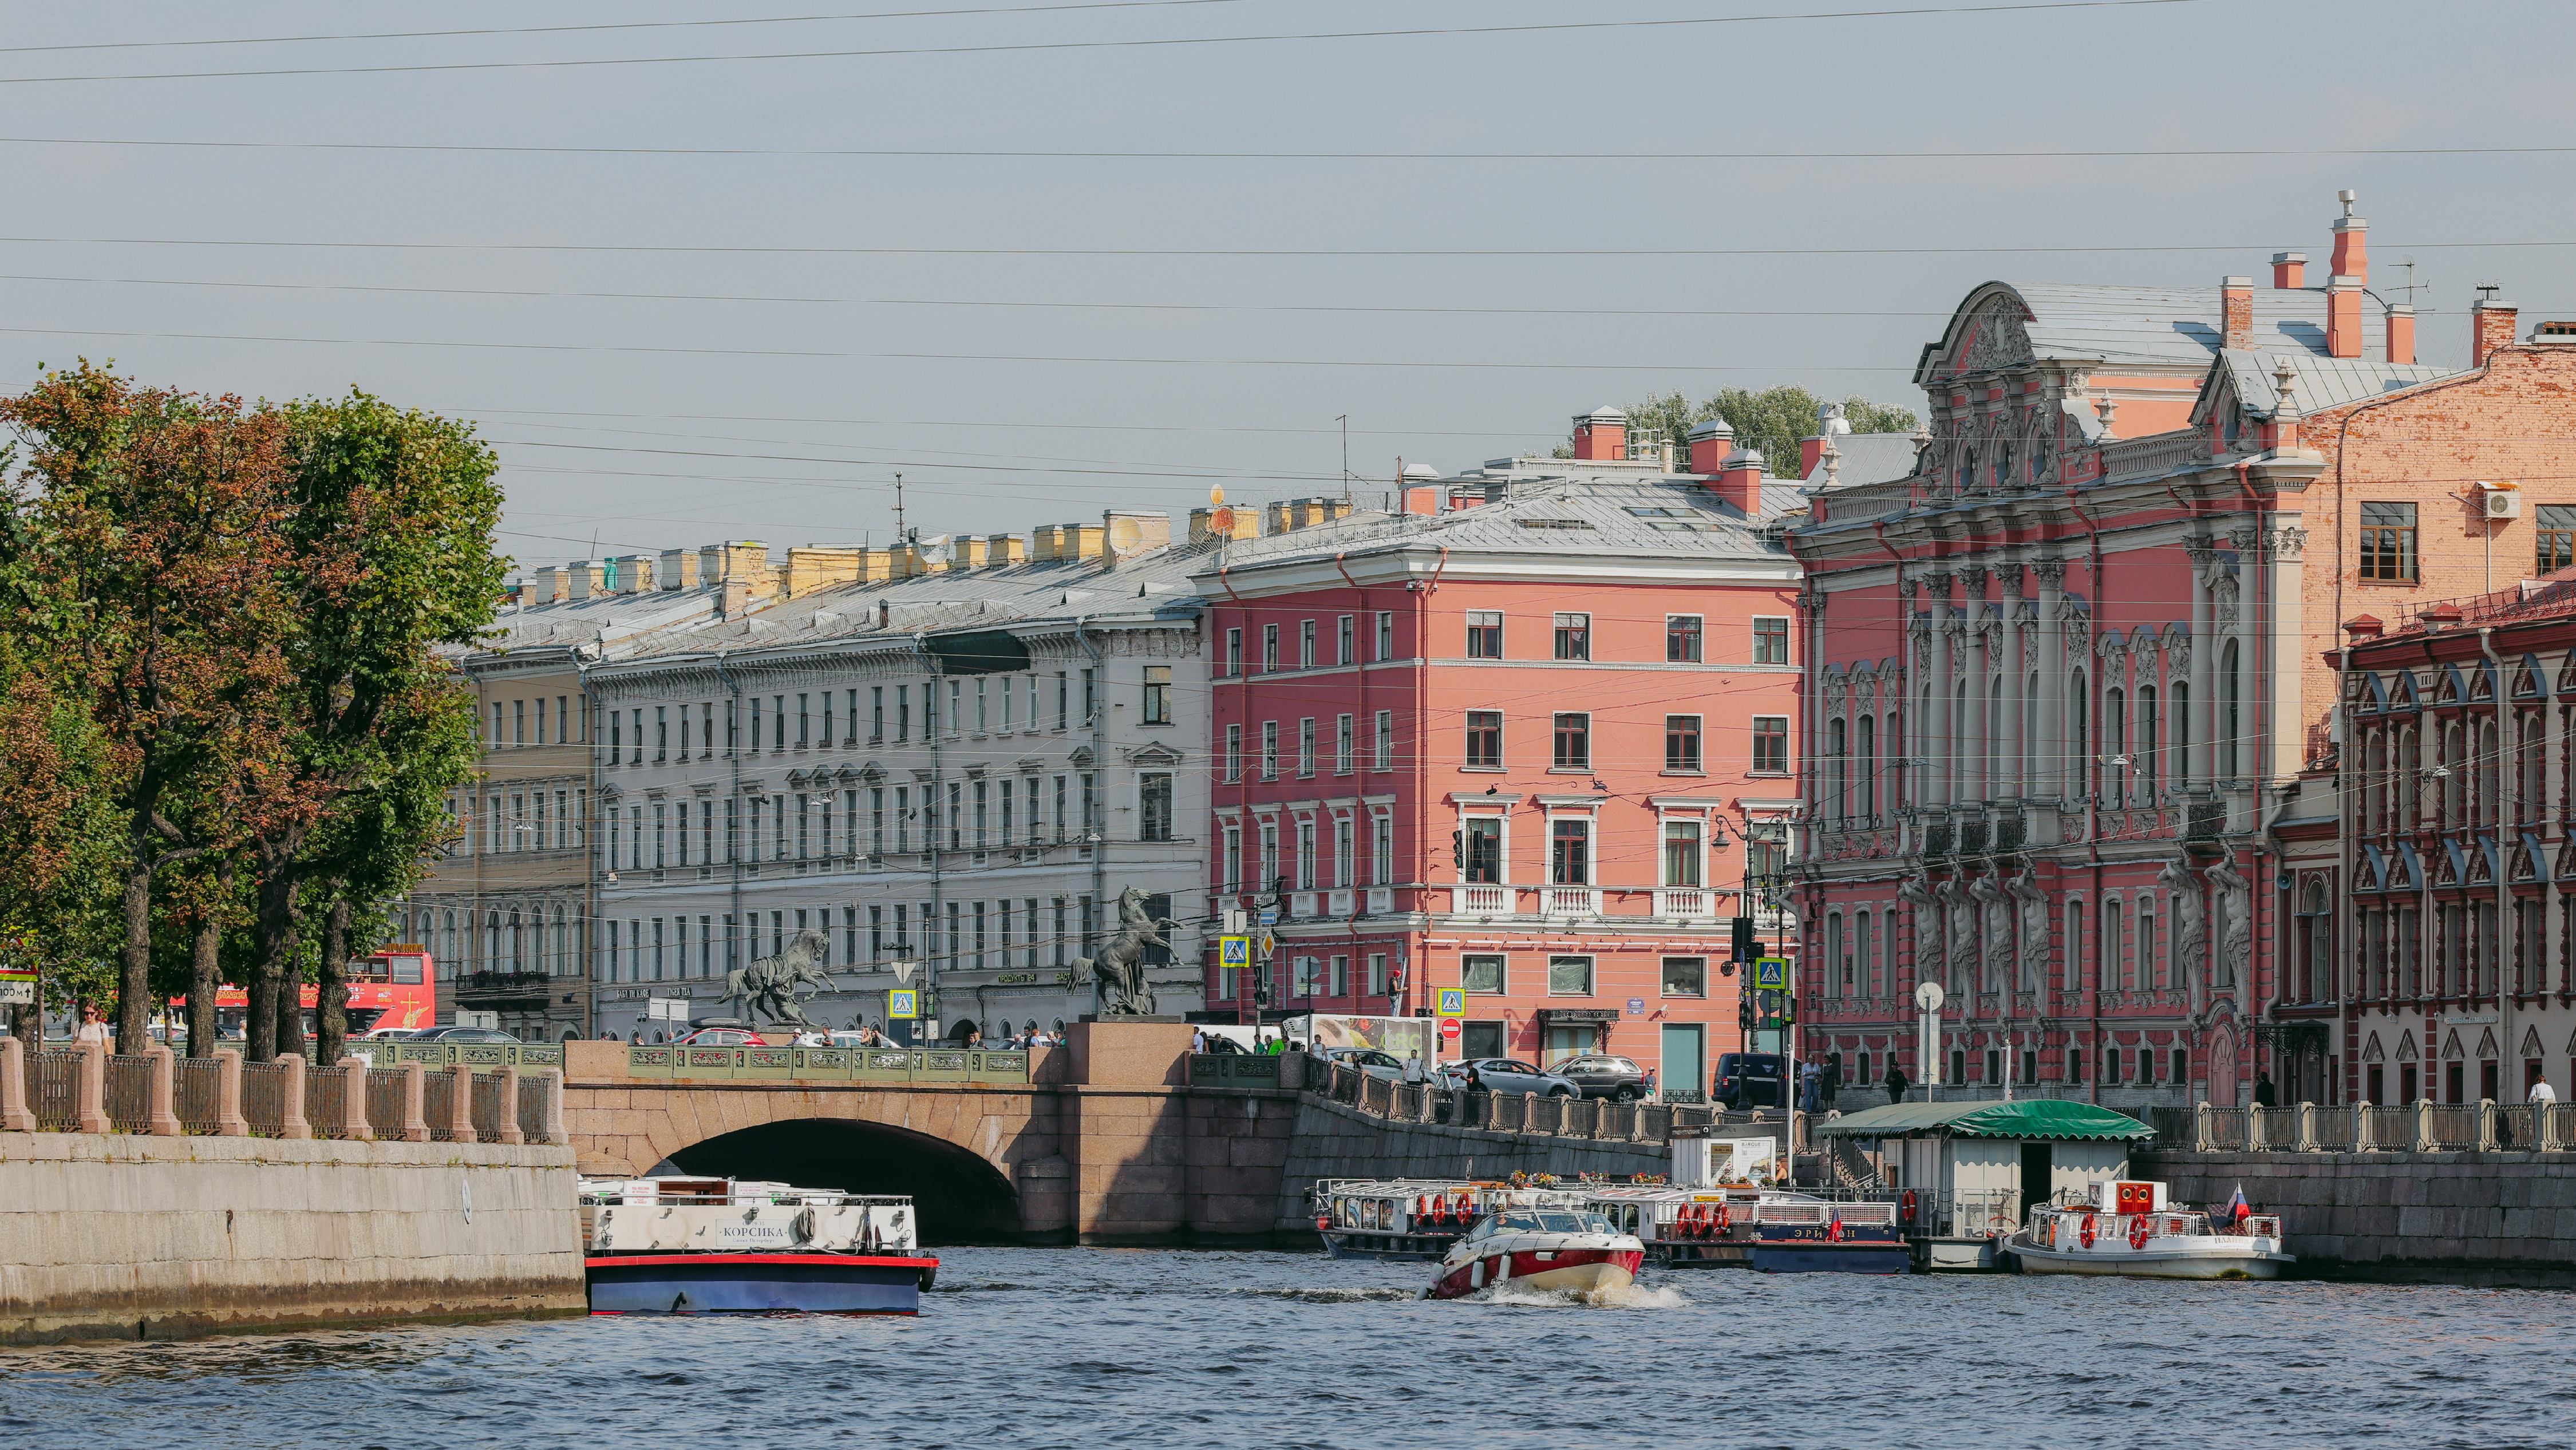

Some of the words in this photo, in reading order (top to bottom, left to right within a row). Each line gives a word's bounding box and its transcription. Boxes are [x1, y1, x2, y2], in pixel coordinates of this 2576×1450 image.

[997, 974, 1025, 983] ПРОДУКТЫ
[617, 990, 628, 998] БАБЛ
[629, 990, 635, 998] ТИ
[636, 989, 650, 997] КАФЕ
[666, 987, 680, 996] TIGER
[681, 987, 691, 995] TEA
[724, 1227, 784, 1236] КОРСИКА
[1795, 1229, 1855, 1238] ЭРИН
